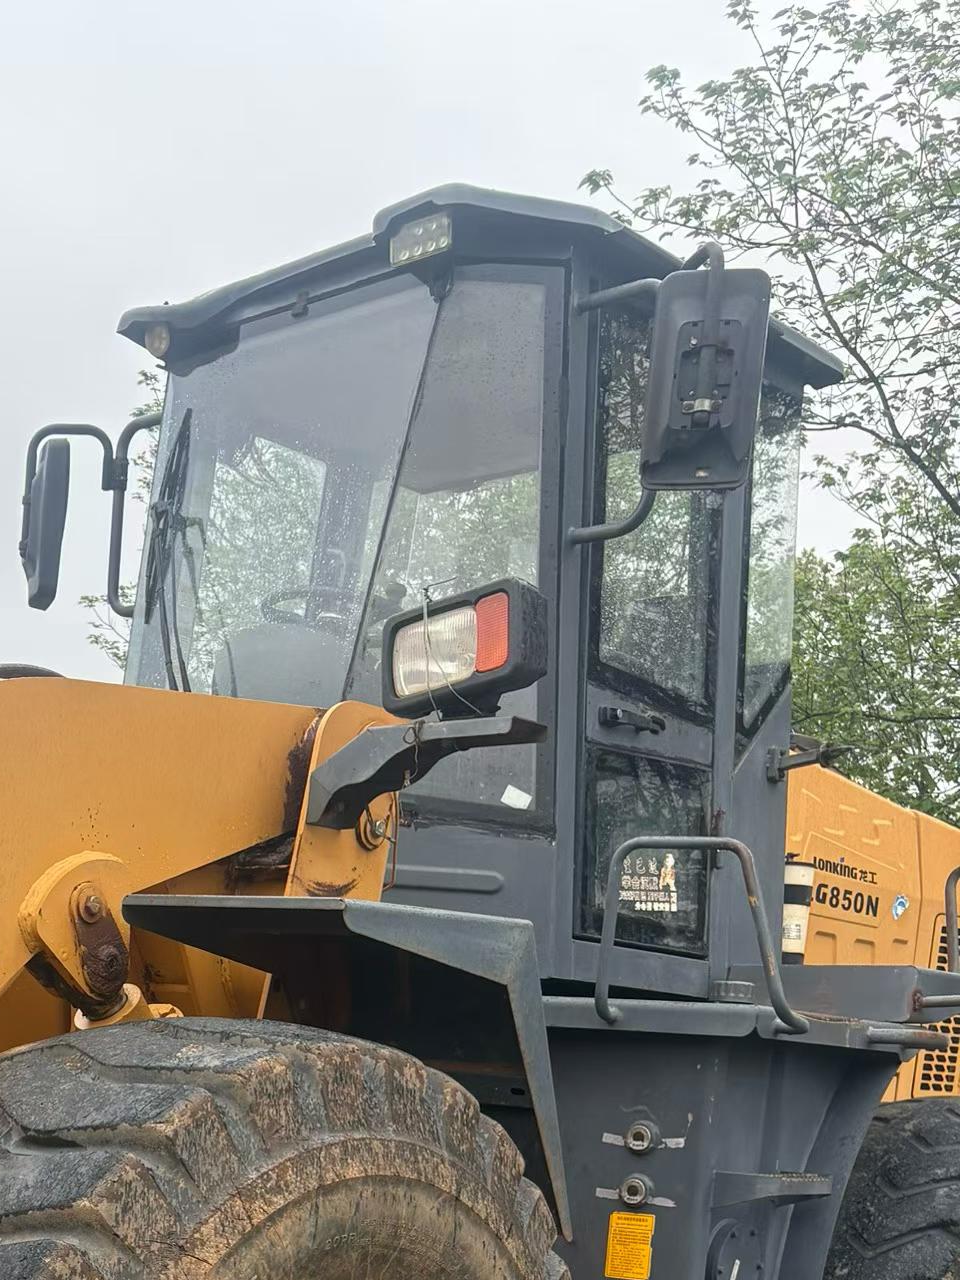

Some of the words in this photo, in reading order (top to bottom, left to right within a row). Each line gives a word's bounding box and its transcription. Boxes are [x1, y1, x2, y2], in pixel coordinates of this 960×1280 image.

[813, 856, 858, 881] LONKING
[858, 868, 878, 885] 龙工
[810, 883, 879, 918] G850N
